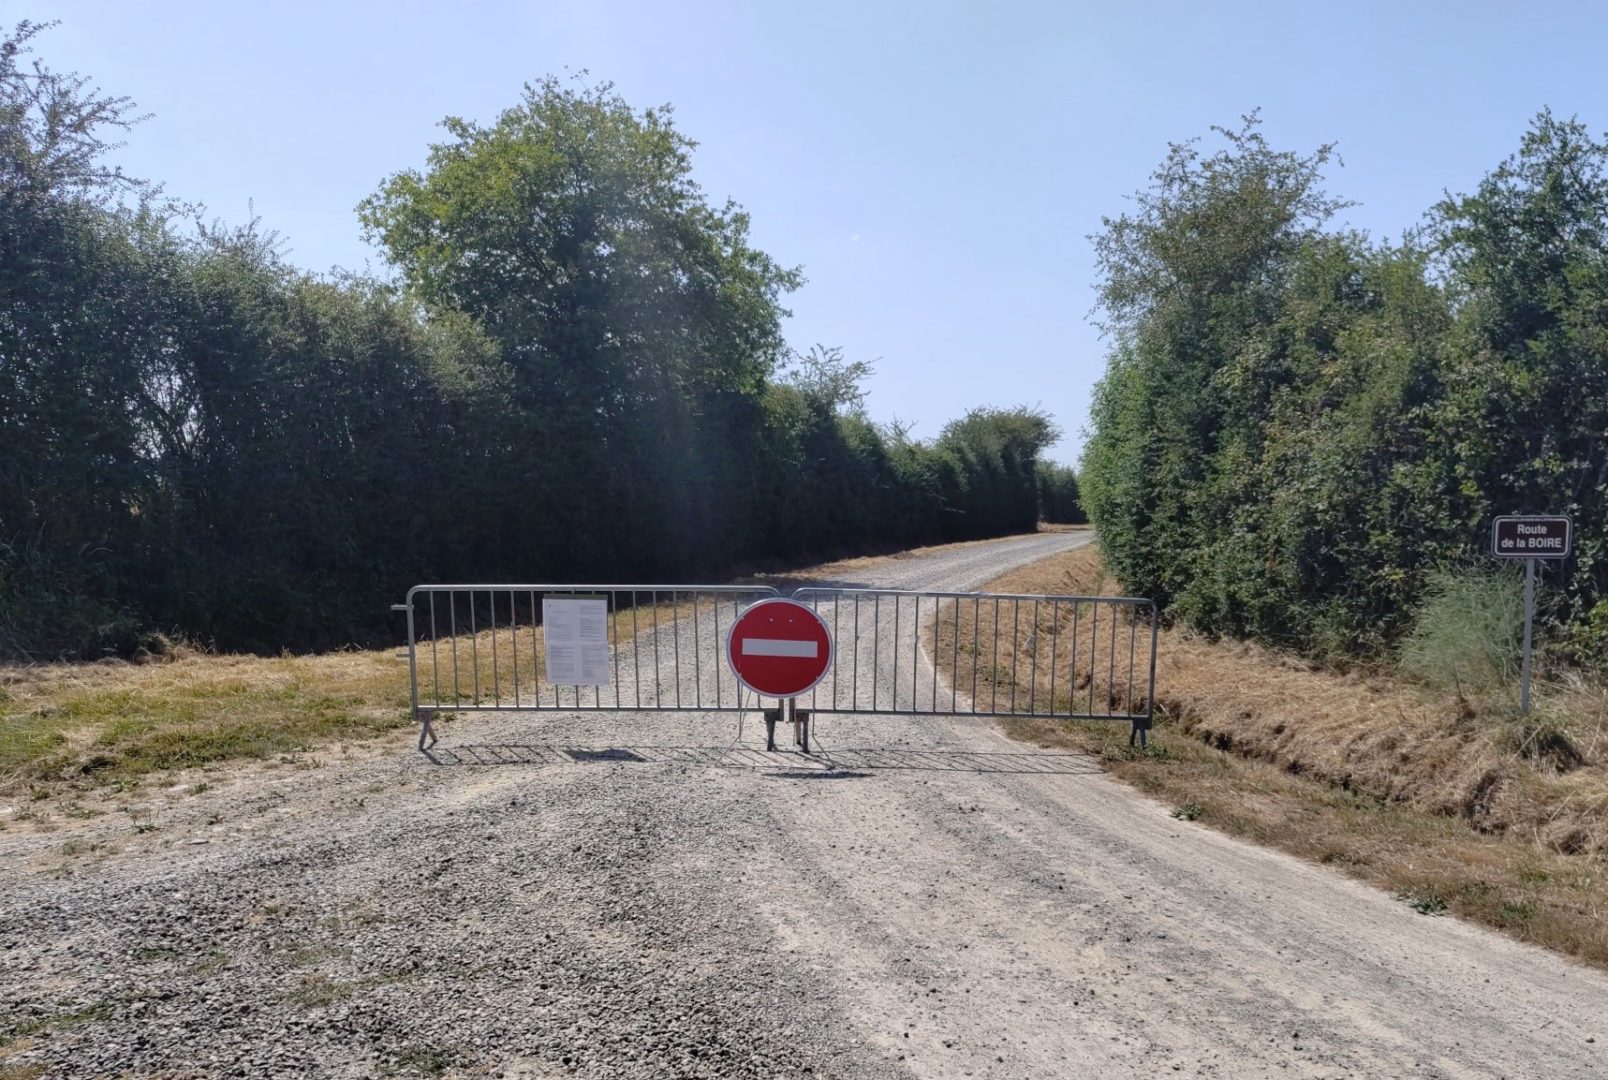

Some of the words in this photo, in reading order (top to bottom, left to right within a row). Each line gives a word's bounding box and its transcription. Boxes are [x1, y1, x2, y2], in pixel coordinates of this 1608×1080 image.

[1517, 524, 1547, 534] Route
[1501, 538, 1514, 548] de
[1516, 538, 1526, 548] la
[1528, 538, 1562, 548] BOIRE
